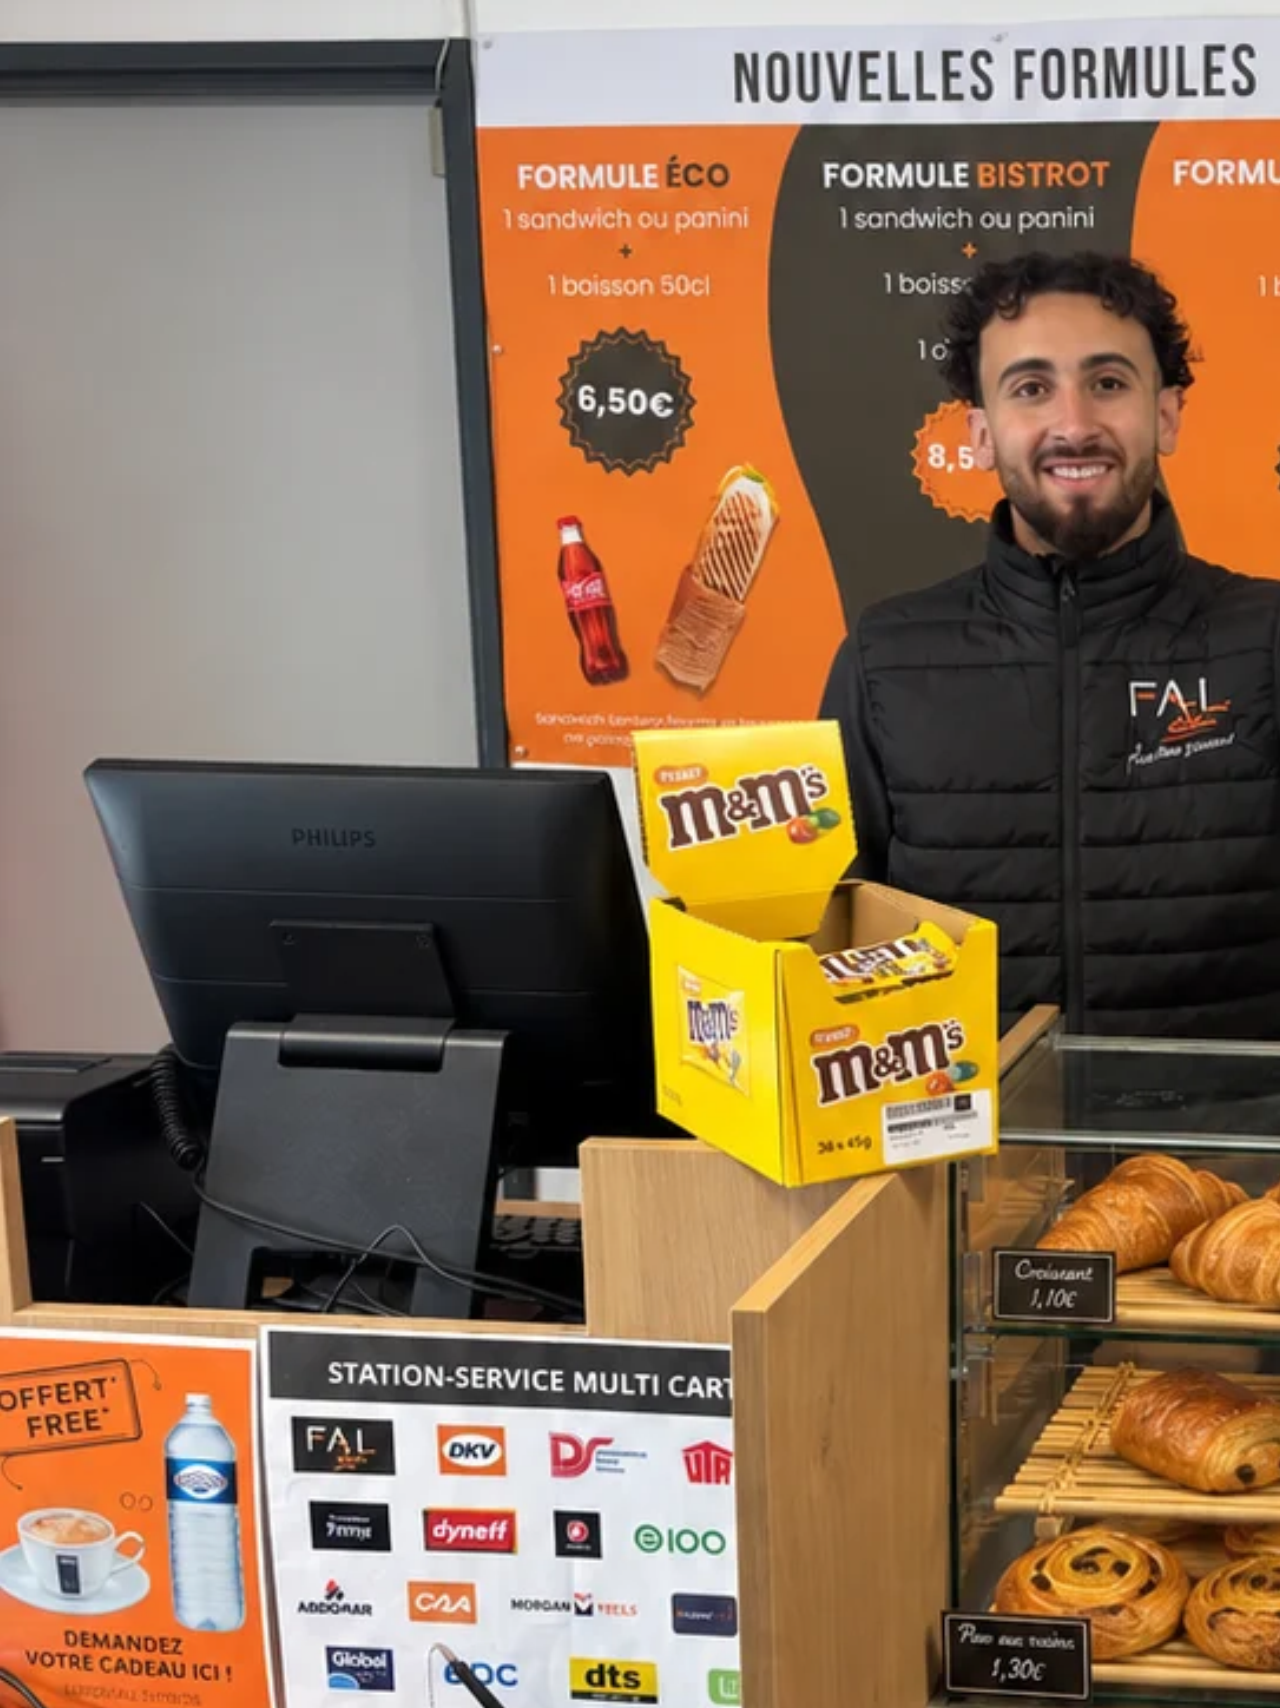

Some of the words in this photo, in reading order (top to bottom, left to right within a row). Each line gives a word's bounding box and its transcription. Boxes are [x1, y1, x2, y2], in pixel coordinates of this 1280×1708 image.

[733, 50, 995, 103] NOUVELLES
[1014, 43, 1258, 100] FORMULES
[517, 163, 659, 190] FORMULE
[666, 154, 730, 189] ÉCO
[823, 162, 970, 189] FORMULE
[977, 161, 1110, 189] BISTROT
[503, 208, 512, 230] 1
[517, 207, 632, 230] sandwich
[637, 212, 668, 230] ou
[674, 206, 749, 235] panini
[839, 206, 848, 229] 1
[854, 207, 974, 229] sandwich
[979, 211, 1011, 229] ou
[1018, 205, 1095, 234] panini
[547, 273, 557, 297] 1
[562, 273, 654, 297] boisson
[660, 273, 711, 297] 50cl
[883, 271, 893, 294] 1
[899, 272, 973, 295] boiss
[1258, 273, 1267, 297] 1
[576, 384, 675, 419] 6,50€
[926, 442, 976, 475] 8,5
[291, 828, 377, 849] PHILIPS
[1030, 1287, 1077, 1309] 1,10€
[328, 1361, 564, 1393] STATION-SERVICE
[573, 1371, 660, 1397] MULTI
[306, 1425, 376, 1455] FAL
[448, 1442, 496, 1459] DKV
[432, 1520, 509, 1543] dyneff
[64, 1630, 184, 1655] DEMANDEZ
[25, 1650, 94, 1672] VOTRE
[100, 1656, 186, 1679] CADEAU
[193, 1664, 220, 1681] ICI
[585, 1663, 642, 1690] dts
[991, 1656, 1046, 1682] 1,30€
